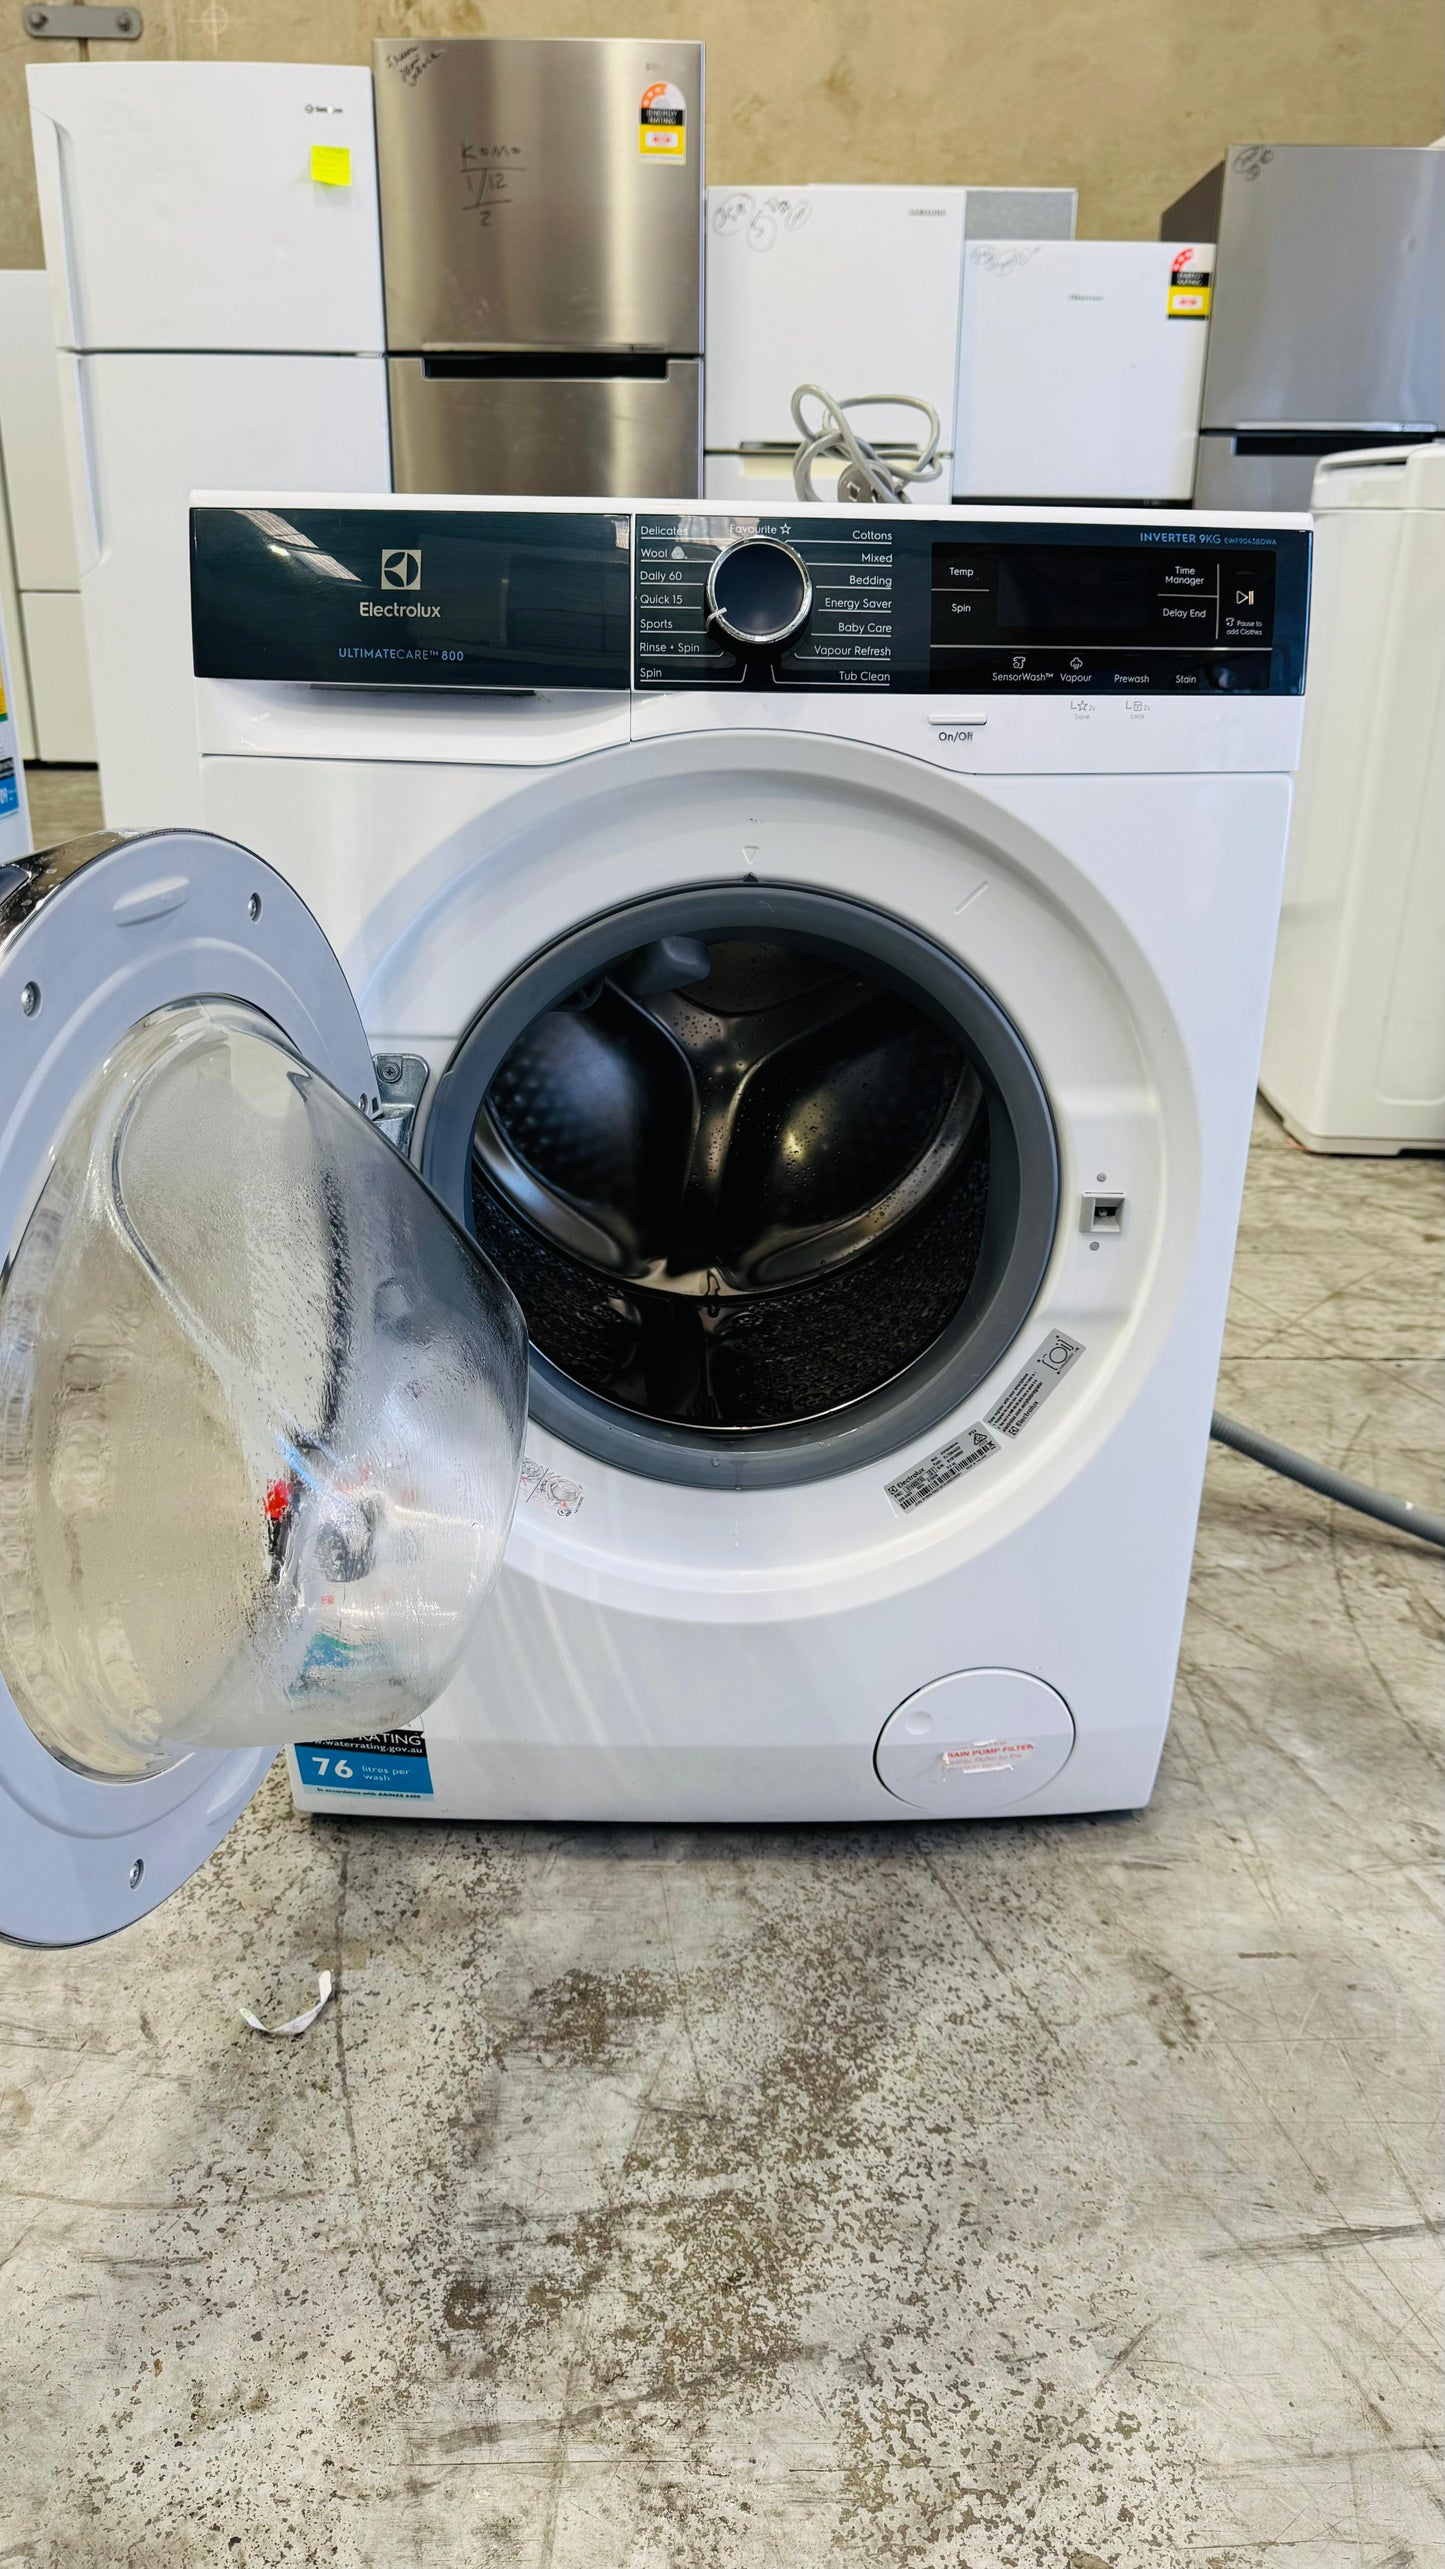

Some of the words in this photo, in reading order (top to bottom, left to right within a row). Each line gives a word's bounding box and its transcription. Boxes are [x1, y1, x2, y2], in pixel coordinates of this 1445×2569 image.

[640, 526, 689, 536] Delicates
[729, 524, 777, 535] Favourite
[852, 530, 893, 541] Cottons
[1140, 532, 1196, 544] INVERTER
[1199, 534, 1221, 544] 9KG
[641, 548, 668, 558] Wool
[861, 553, 893, 563] Mixed
[949, 566, 974, 577] Temp
[1175, 566, 1196, 575] Time
[640, 571, 666, 583] Daily
[669, 571, 683, 581] 60
[849, 575, 893, 587] Bedding
[1165, 575, 1205, 587] Manager
[640, 594, 670, 604] Quick
[672, 594, 683, 605] 15
[825, 597, 859, 610] Energy
[862, 599, 892, 609] Saver
[360, 601, 441, 618] Electrolux
[951, 603, 971, 614] Spin
[1162, 608, 1188, 620] Delay
[1189, 608, 1207, 618] End
[640, 618, 673, 630] Sports
[838, 622, 865, 635] Baby
[867, 623, 892, 633] Care
[1236, 620, 1255, 628] Pause
[1226, 628, 1239, 636] add
[640, 642, 667, 652] Rinse
[677, 643, 700, 653] Spin
[814, 645, 851, 656] Vapour
[854, 646, 891, 656] Refresh
[441, 650, 464, 661] 800
[640, 667, 662, 678] Spin
[839, 670, 857, 681] Tub
[860, 671, 891, 682] Clean
[1060, 673, 1092, 684] Vapour
[1114, 674, 1150, 683] Prewash
[1175, 674, 1197, 684] Stain
[1074, 713, 1090, 721] Save
[938, 731, 974, 742] On/Off
[1015, 1401, 1039, 1427] Electrolux
[896, 1468, 925, 1489] Electrolux
[314, 1739, 423, 1754] .waterrating.gov.au
[972, 1747, 1001, 1756] PUMP
[312, 1756, 354, 1779] 76
[361, 1764, 389, 1774] litres
[392, 1767, 411, 1776] per
[363, 1774, 391, 1782] wash
